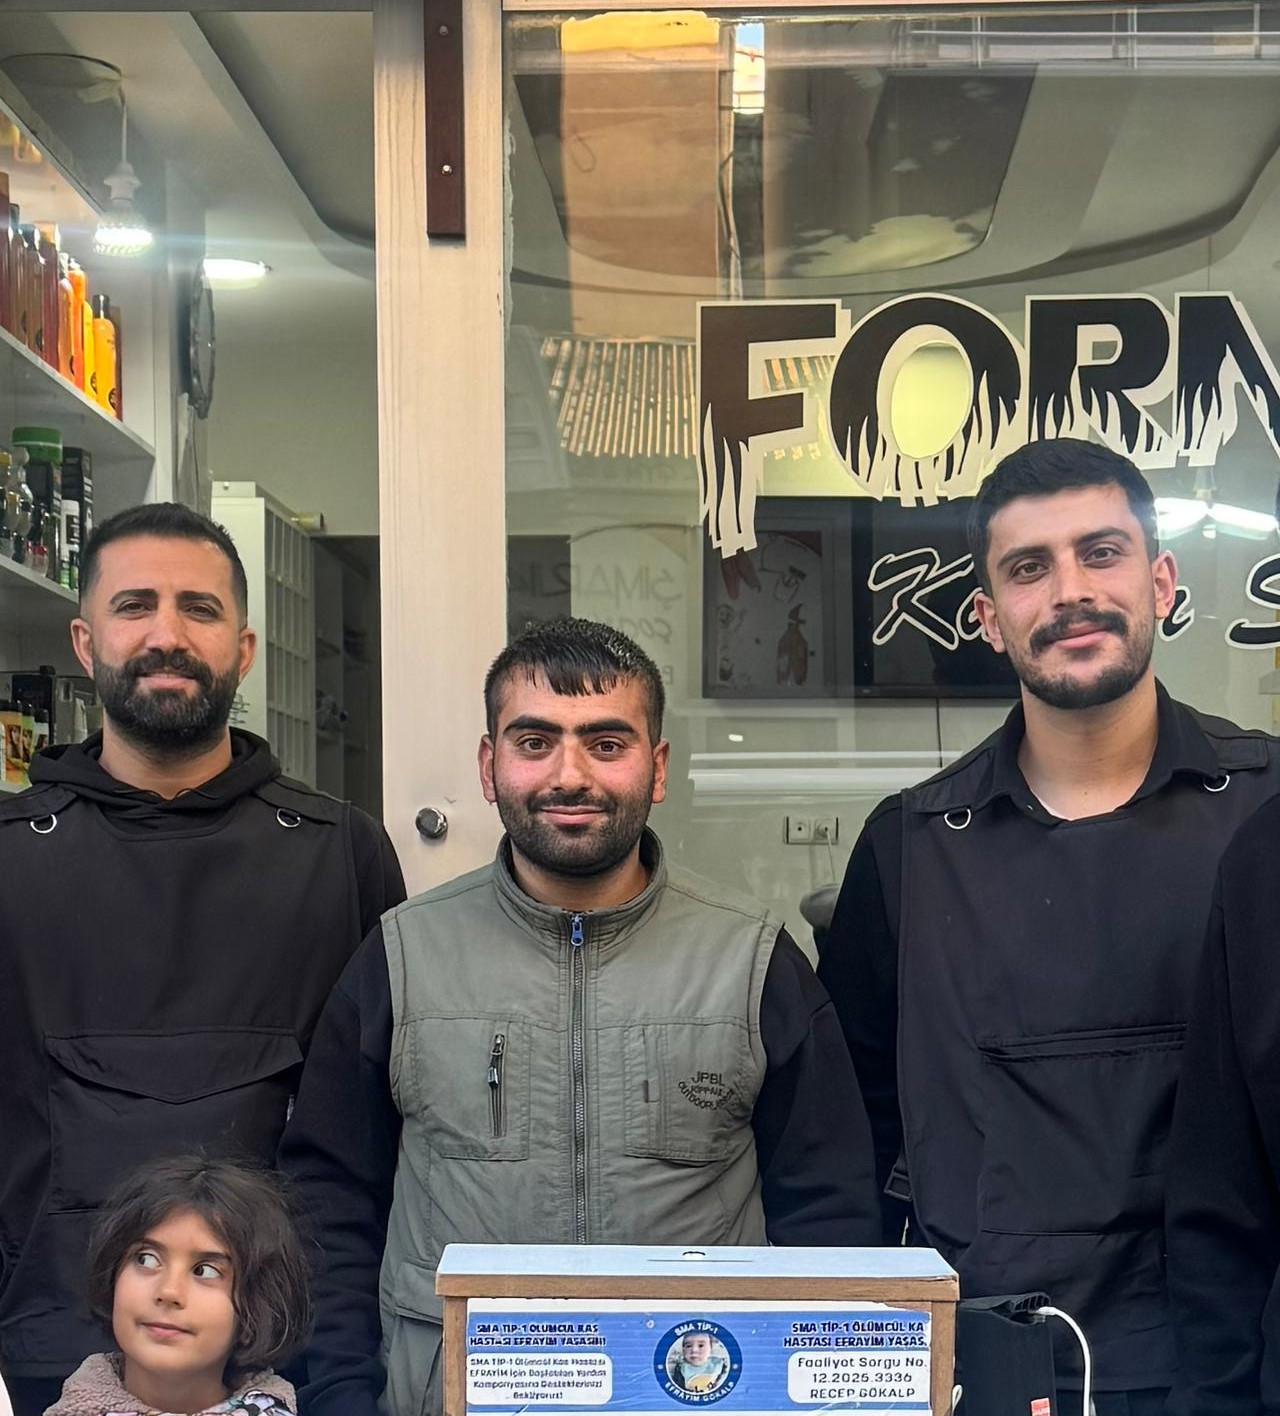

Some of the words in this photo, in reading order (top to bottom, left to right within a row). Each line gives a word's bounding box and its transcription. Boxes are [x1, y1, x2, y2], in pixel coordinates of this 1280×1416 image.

[792, 1322, 817, 1333] SMA
[822, 1321, 850, 1332] TİP-1
[783, 1337, 831, 1347] HASTASI
[798, 1357, 855, 1369] Faaliyet
[859, 1357, 901, 1369] Sorgu
[810, 1388, 856, 1399] RECEP
